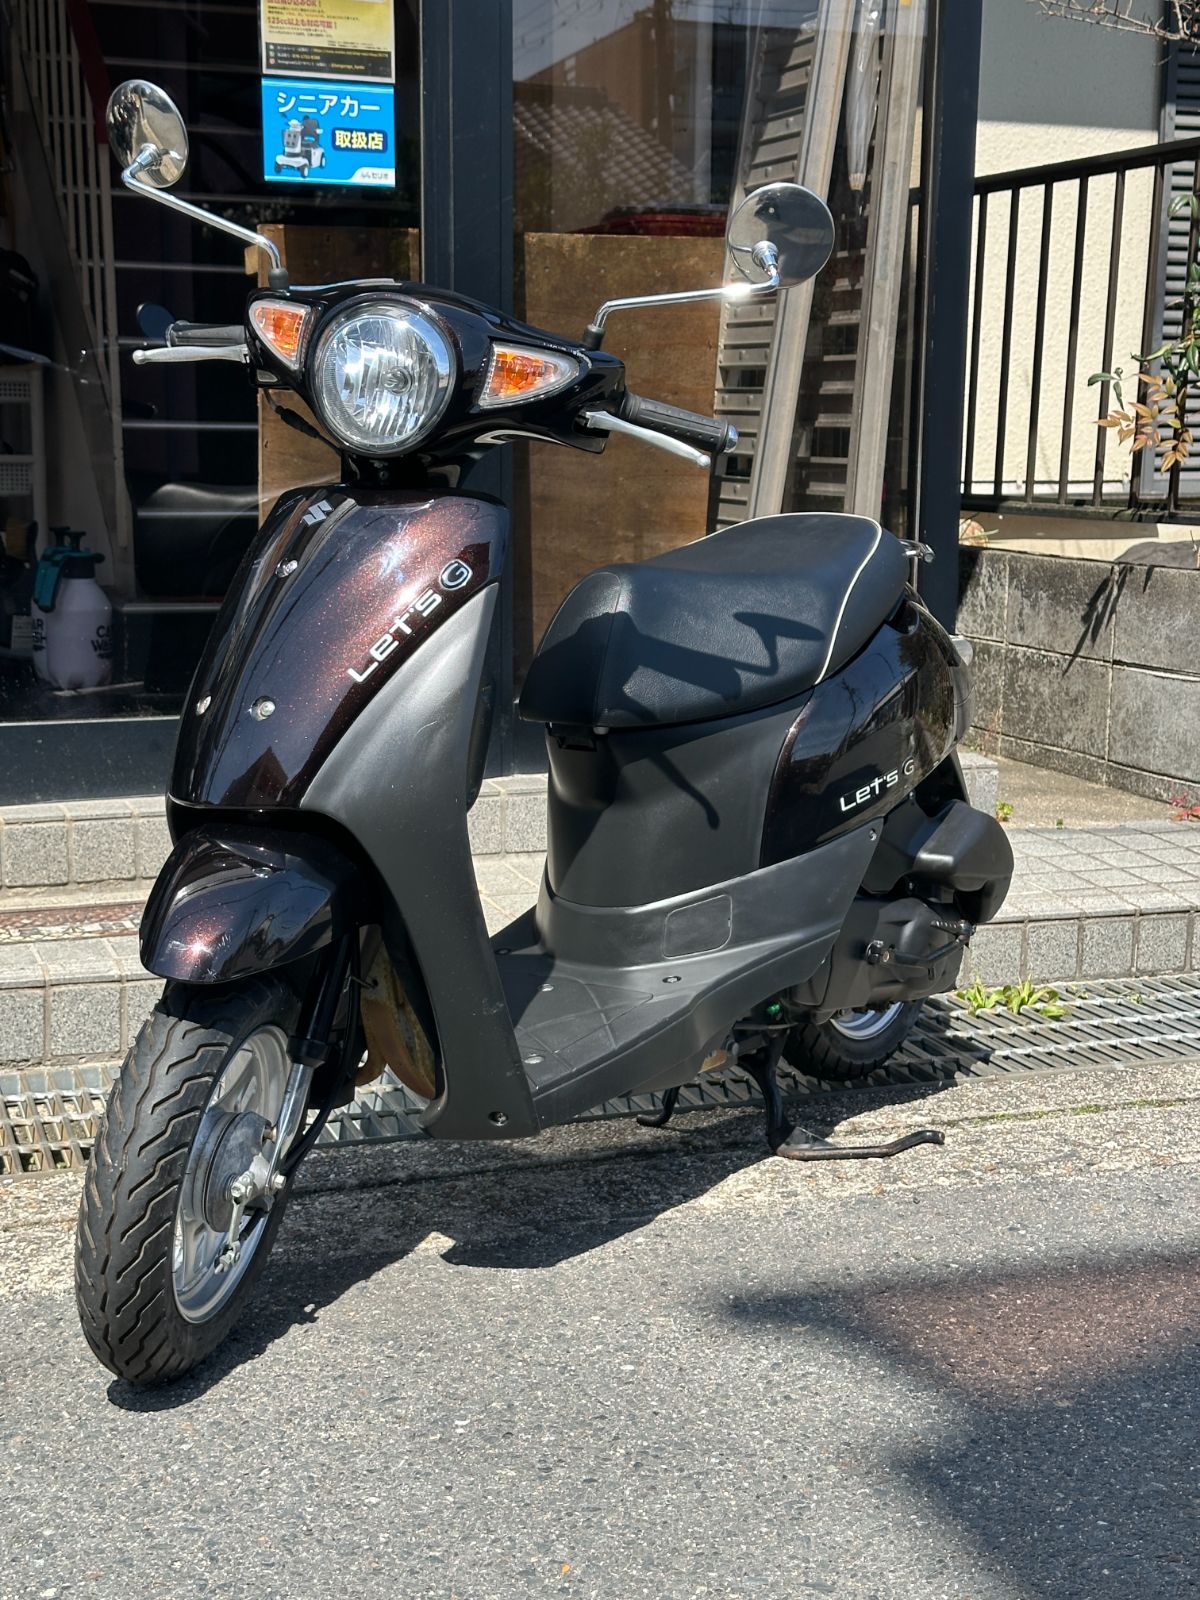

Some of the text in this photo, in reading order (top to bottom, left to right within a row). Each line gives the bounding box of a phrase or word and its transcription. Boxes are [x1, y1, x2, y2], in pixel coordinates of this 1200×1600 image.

[276, 91, 380, 117] シニアカー
[334, 129, 384, 150] 取扱店
[440, 560, 471, 588] G
[903, 758, 915, 776] G
